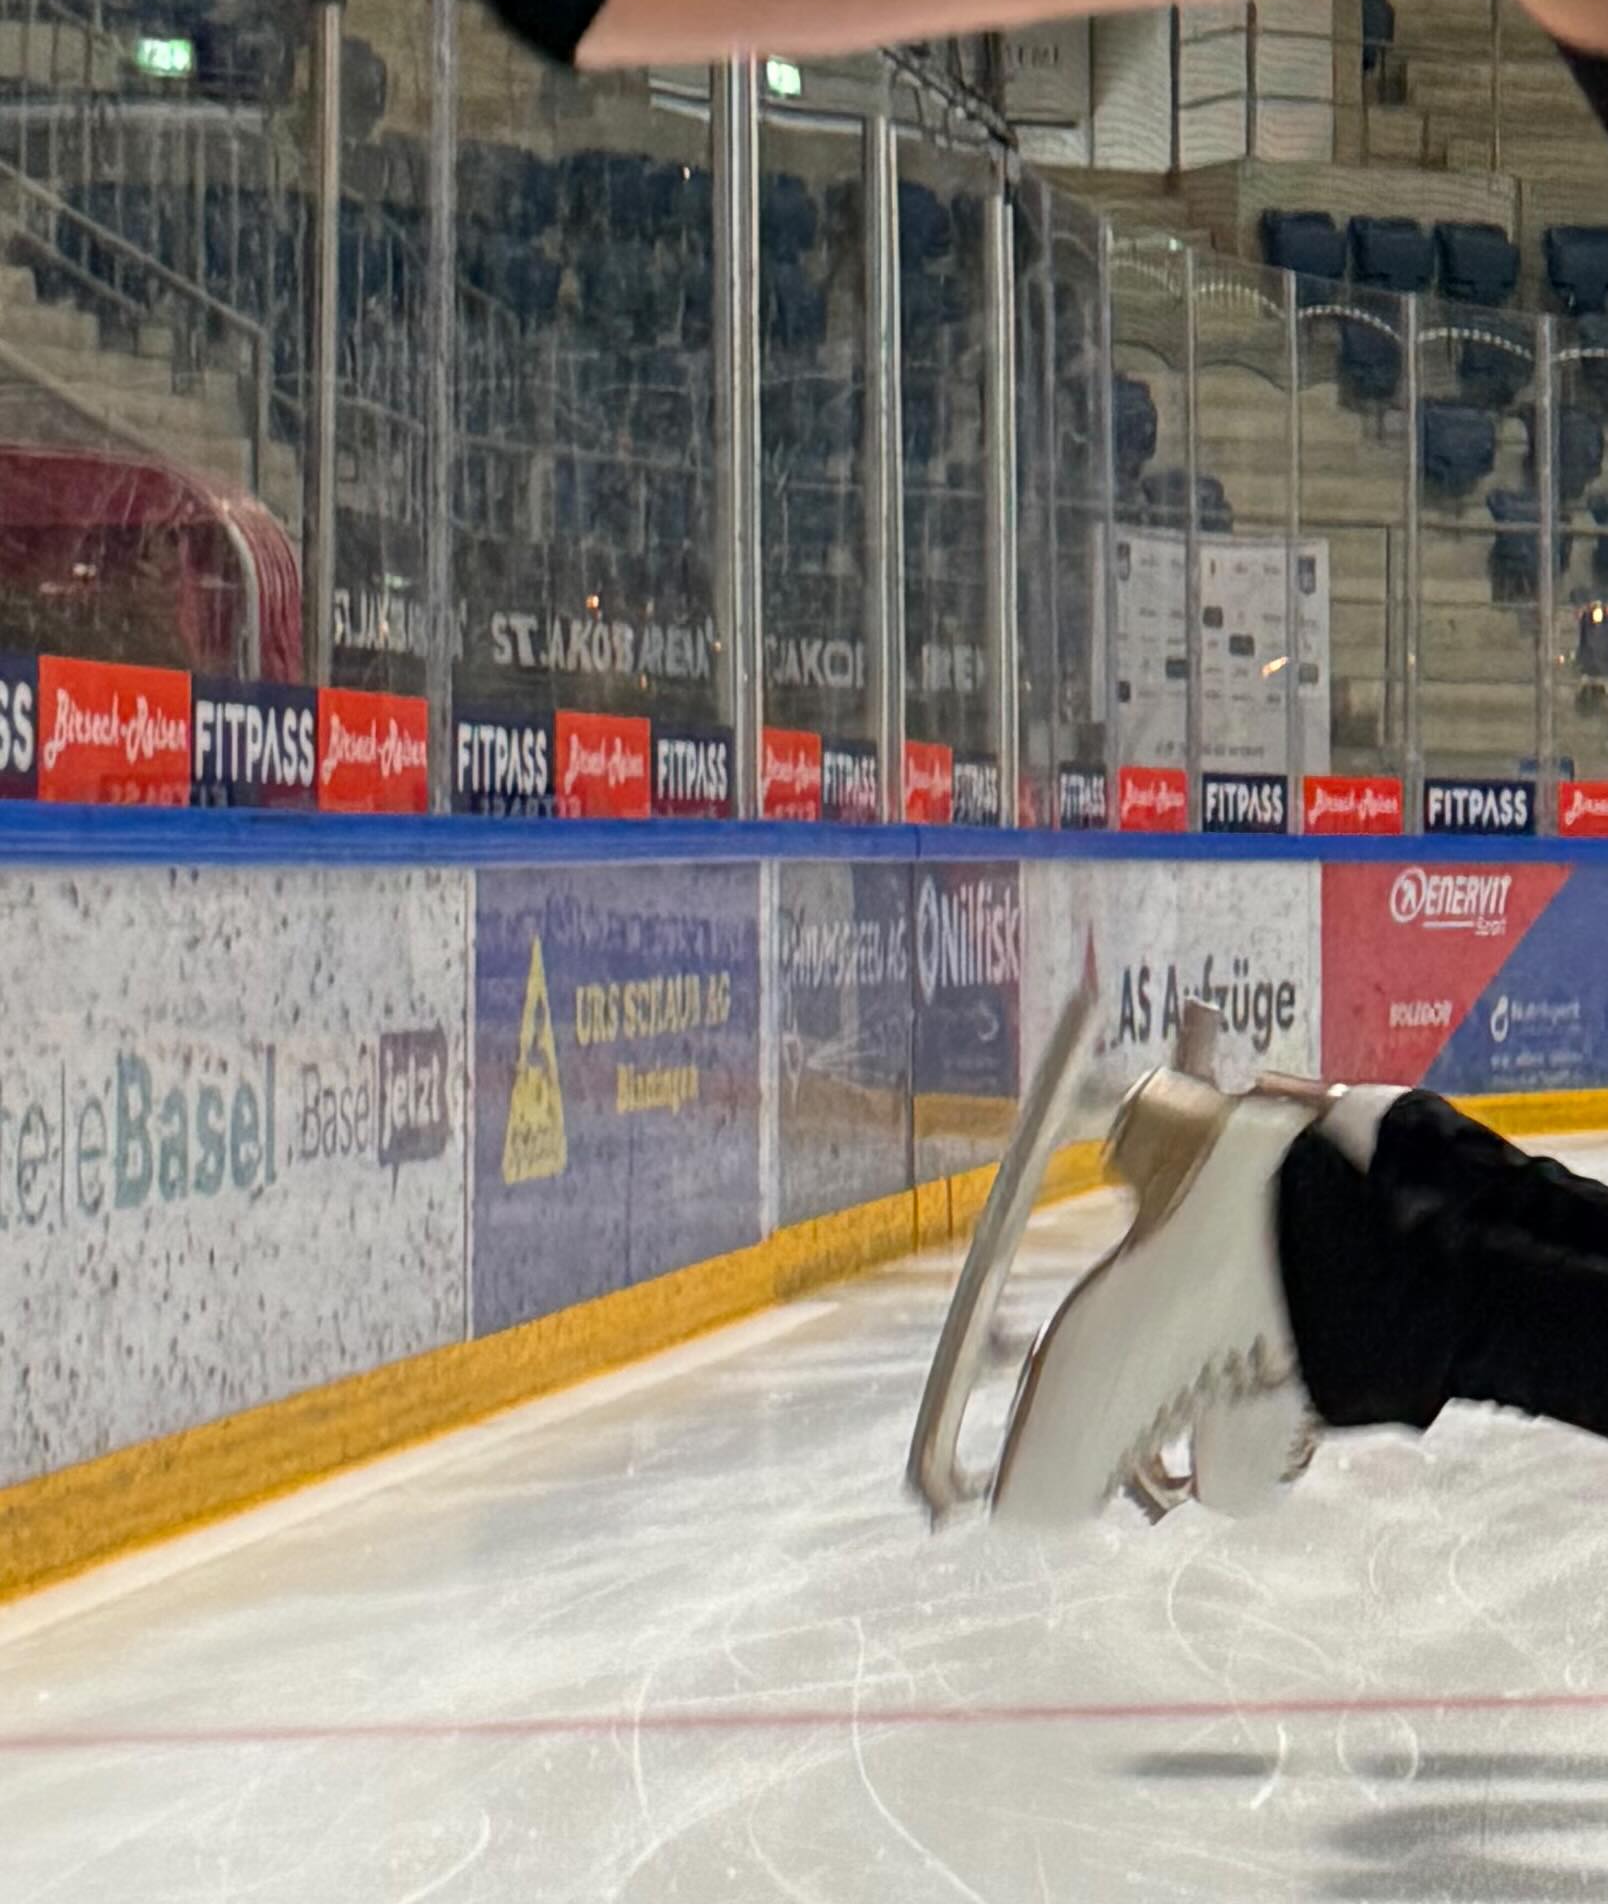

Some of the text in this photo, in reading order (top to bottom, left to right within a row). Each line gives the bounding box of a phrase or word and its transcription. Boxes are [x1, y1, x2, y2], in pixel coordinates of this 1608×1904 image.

[195, 699, 315, 787] FITPASS
[457, 721, 548, 796] FITPASS
[656, 739, 729, 802] FITPASS
[1205, 781, 1284, 824] FITPASS
[1428, 788, 1528, 827] FITPASS
[940, 878, 1020, 988] Nilfisk
[576, 982, 619, 1046] URS
[1119, 953, 1296, 1055] AS Afzüge
[0, 1041, 277, 1228] eleBasel
